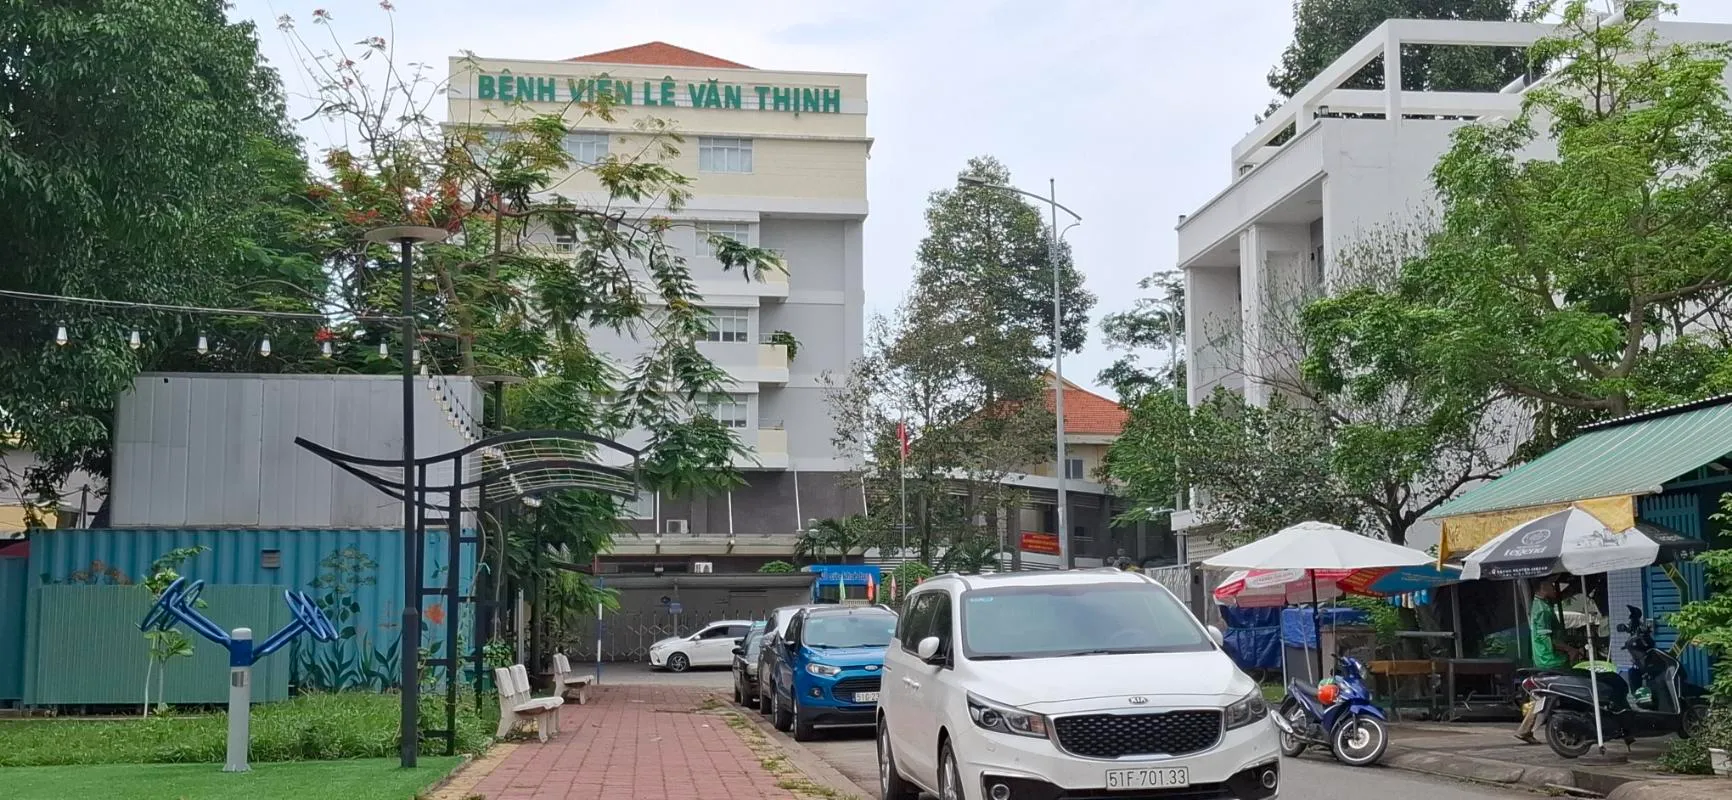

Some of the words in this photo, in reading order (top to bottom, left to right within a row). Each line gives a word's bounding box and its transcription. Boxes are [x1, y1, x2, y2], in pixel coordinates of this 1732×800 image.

[478, 68, 556, 106] BỆNH
[643, 75, 676, 107] LÊ
[687, 77, 741, 109] VĂN
[754, 85, 841, 117] THỊNH
[1504, 545, 1548, 557] Legend
[1109, 769, 1186, 787] 51F-701.33
